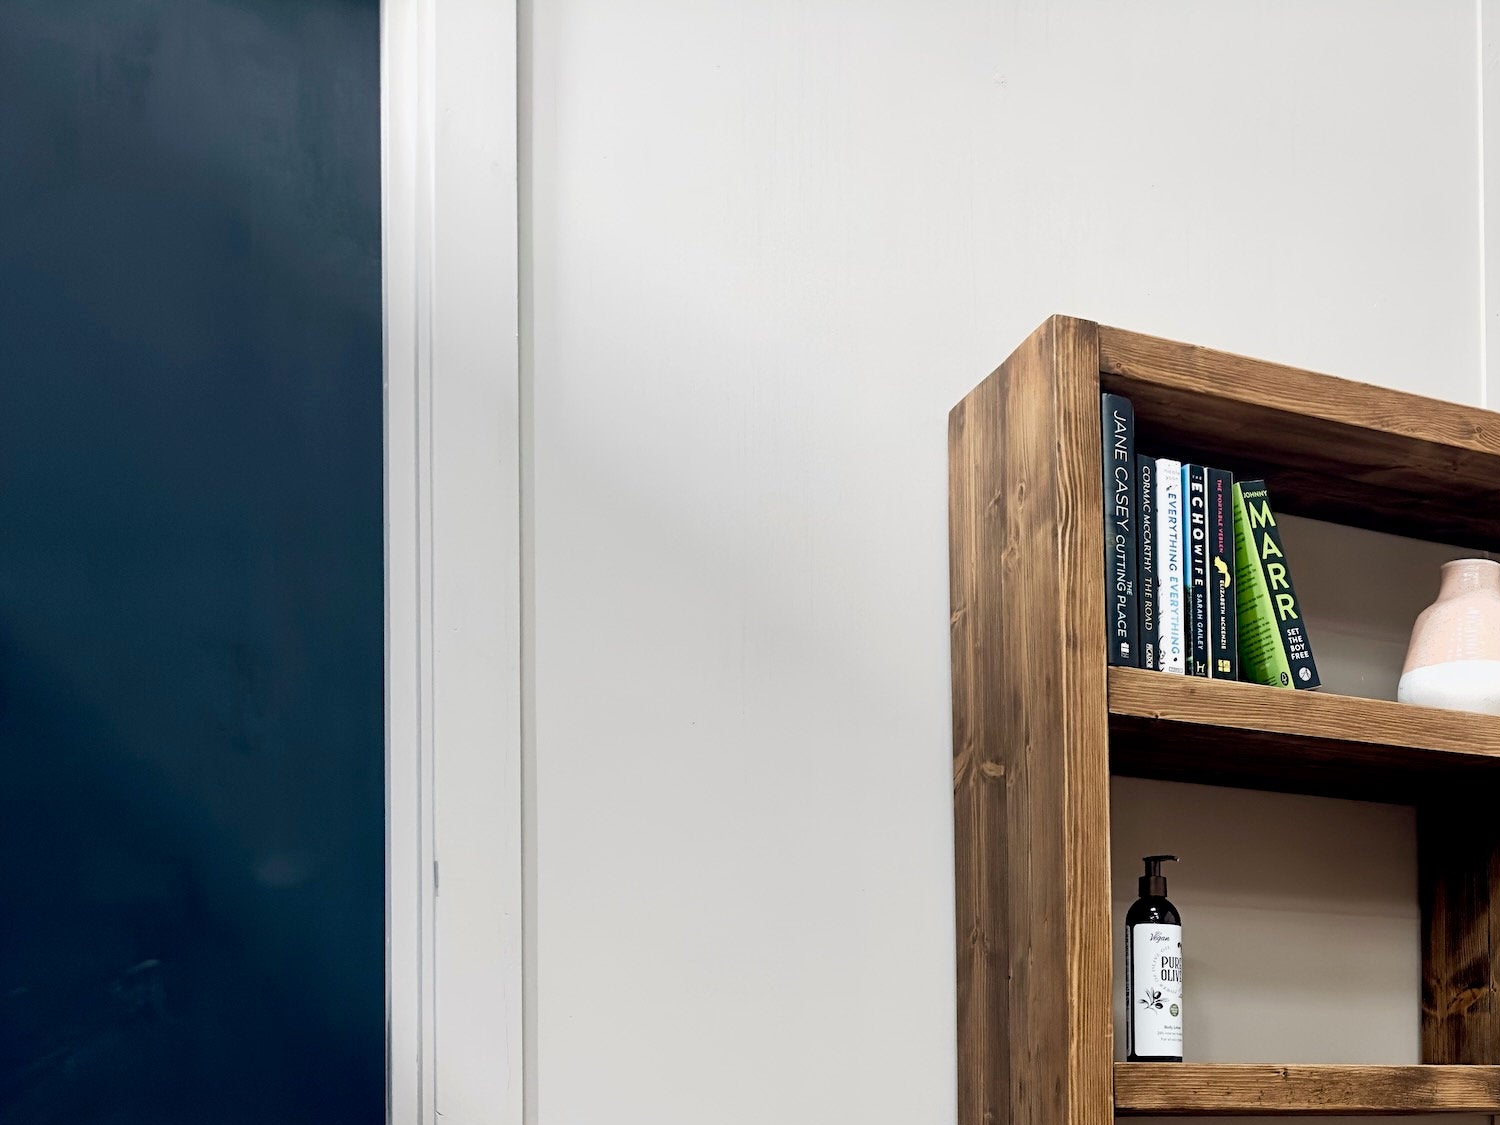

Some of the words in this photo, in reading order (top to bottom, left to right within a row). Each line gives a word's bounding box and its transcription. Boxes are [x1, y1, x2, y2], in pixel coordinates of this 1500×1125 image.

[1113, 410, 1127, 462] JANE
[1115, 466, 1129, 531] CASEY
[1143, 465, 1151, 512] CORMAC
[1243, 490, 1267, 499] JOHNNY
[1168, 493, 1177, 572] EVERYTHING
[1116, 534, 1126, 592] CUTTING
[1248, 499, 1299, 622] MARR
[1144, 577, 1152, 599] THE
[1117, 594, 1127, 637] PLACE
[1145, 600, 1153, 631] ROAD
[1169, 577, 1180, 655] EVERYTHING
[1196, 593, 1204, 620] SARAH
[1196, 622, 1204, 651] GAILEY
[1287, 627, 1300, 637] SET
[1288, 635, 1304, 645] THE
[1290, 643, 1306, 653] BOY
[1291, 650, 1310, 661] FREE
[1150, 932, 1170, 943] Vegan
